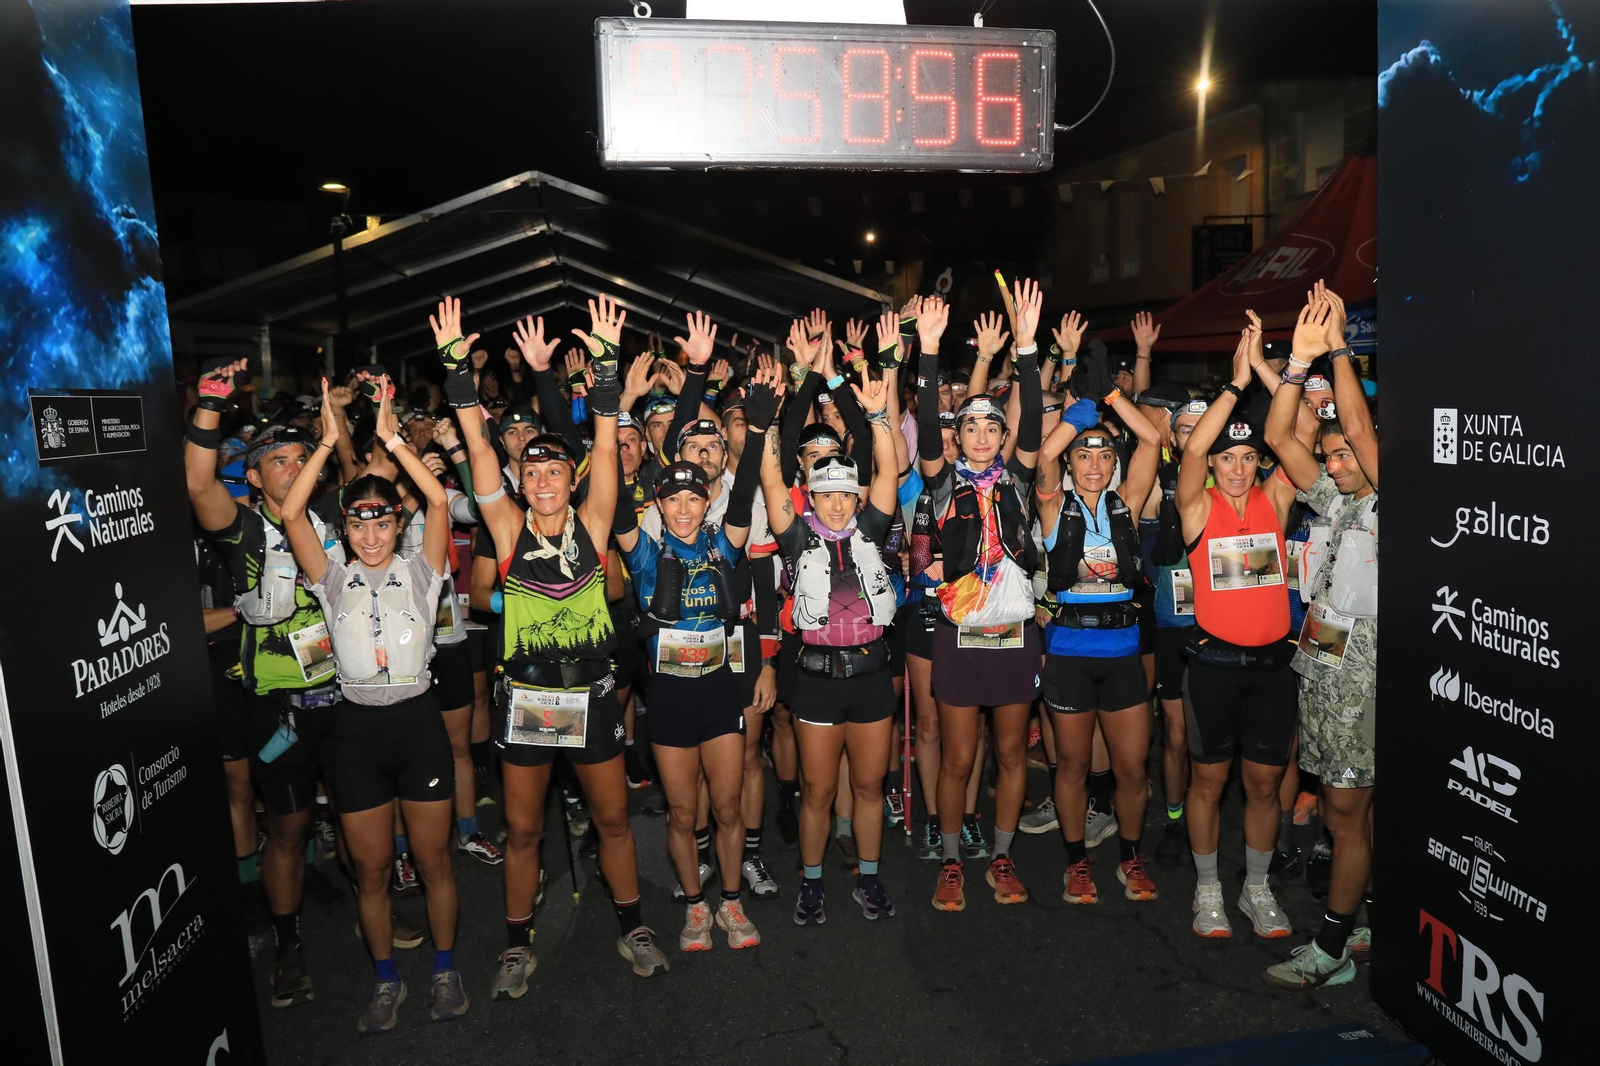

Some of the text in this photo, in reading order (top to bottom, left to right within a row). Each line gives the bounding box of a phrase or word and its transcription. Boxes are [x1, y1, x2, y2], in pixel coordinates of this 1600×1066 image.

[67, 419, 89, 427] GOBERNO
[75, 425, 90, 433] ESPAÑA
[1463, 413, 1524, 437] XUNTA
[1462, 440, 1566, 468] DE GALICIA
[85, 484, 144, 518] Caminos
[89, 508, 154, 547] Naturales
[1430, 501, 1550, 548] galicia
[1243, 553, 1251, 570] 1
[1311, 621, 1320, 639] 2
[1471, 597, 1550, 641] Caminos
[71, 622, 171, 699] PARADORES
[676, 647, 709, 662] 339
[1471, 620, 1561, 669] Naturales
[99, 672, 161, 719] Hoteles desde 1928
[1464, 682, 1555, 739] Iberdrola
[138, 745, 180, 785] Consorcio
[101, 792, 124, 814] RIBEIRA
[141, 765, 187, 810] de Turismo
[1447, 778, 1519, 823] PADEL
[105, 805, 123, 825] SACRA
[1473, 835, 1494, 856] GRUPO
[121, 913, 204, 1015] melsacra
[122, 926, 206, 1024] MIEL TRADICIONAL
[1418, 907, 1545, 1064] TRS
